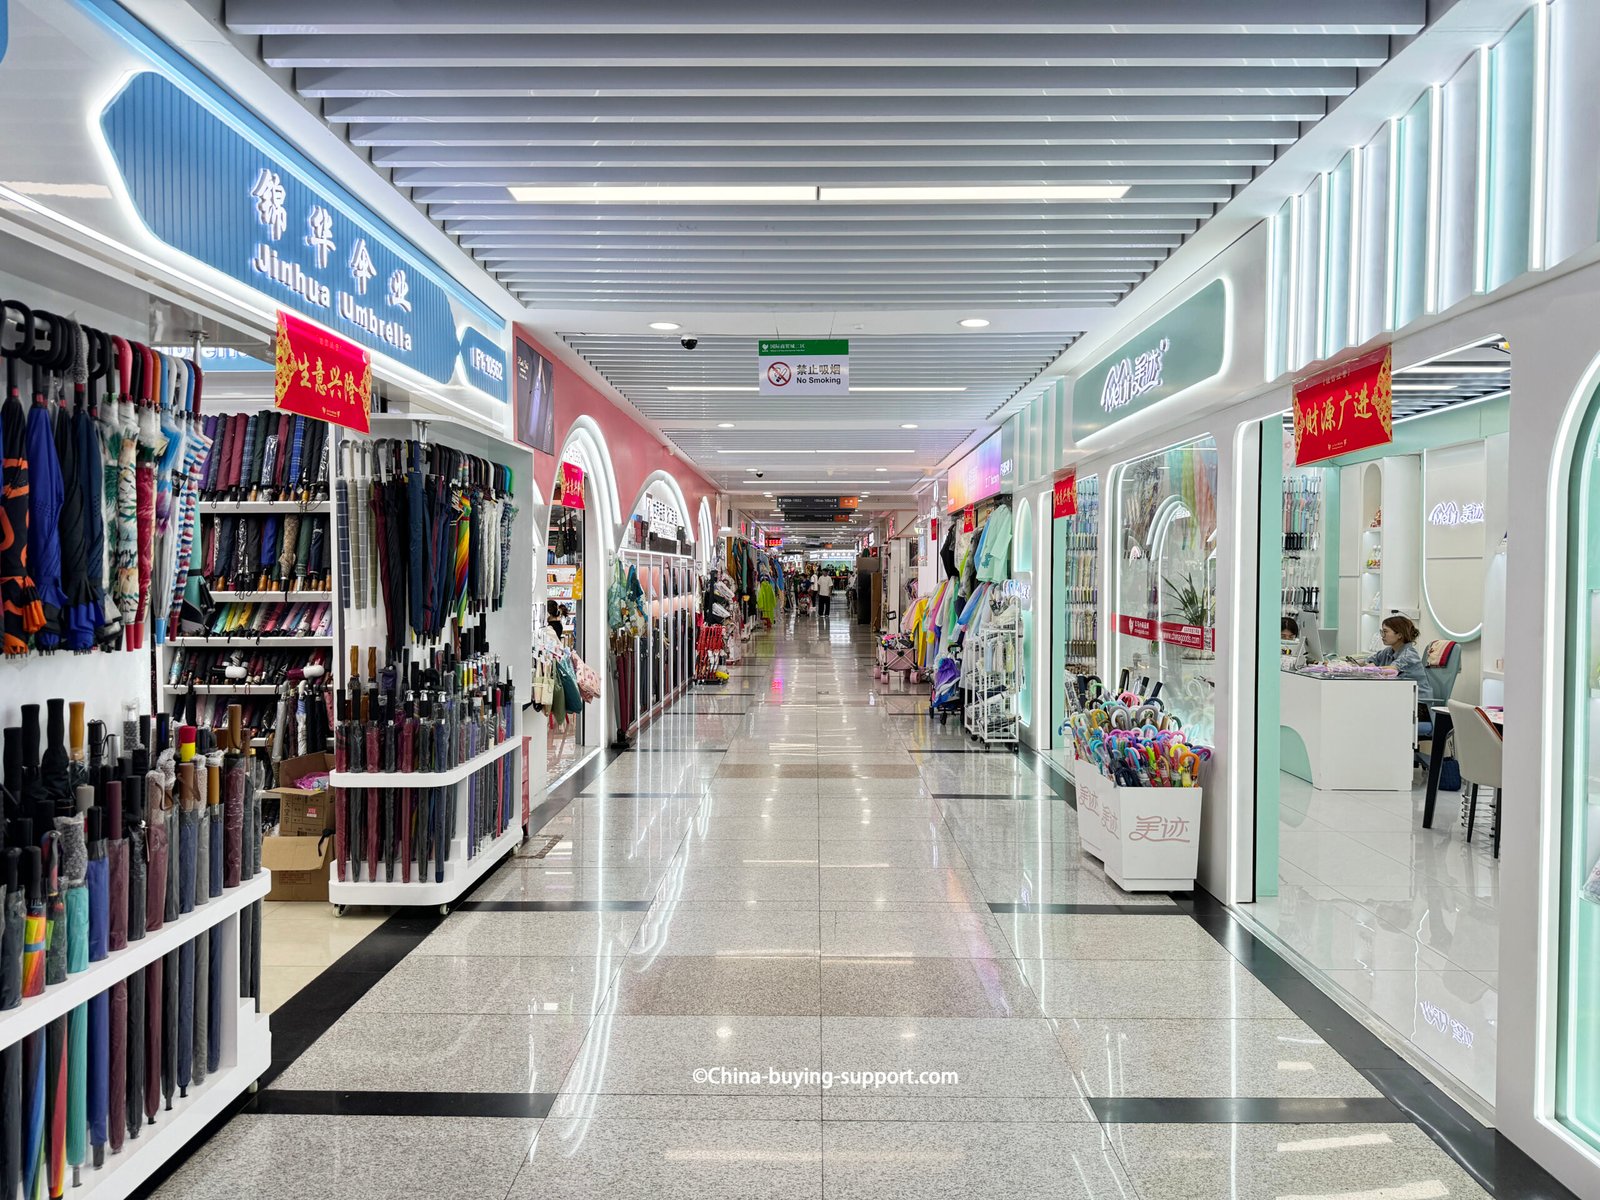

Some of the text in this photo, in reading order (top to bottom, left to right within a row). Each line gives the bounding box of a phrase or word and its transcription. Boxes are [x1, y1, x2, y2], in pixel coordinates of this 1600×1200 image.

[252, 168, 412, 313] 锦华伞业
[252, 243, 412, 351] Jinhua Umbrella
[298, 352, 359, 404] 生意兴隆
[797, 364, 840, 375] 禁止吸烟
[809, 377, 841, 385] Smoking
[1306, 382, 1373, 436] 财源广进
[1128, 815, 1191, 843] 美迹
